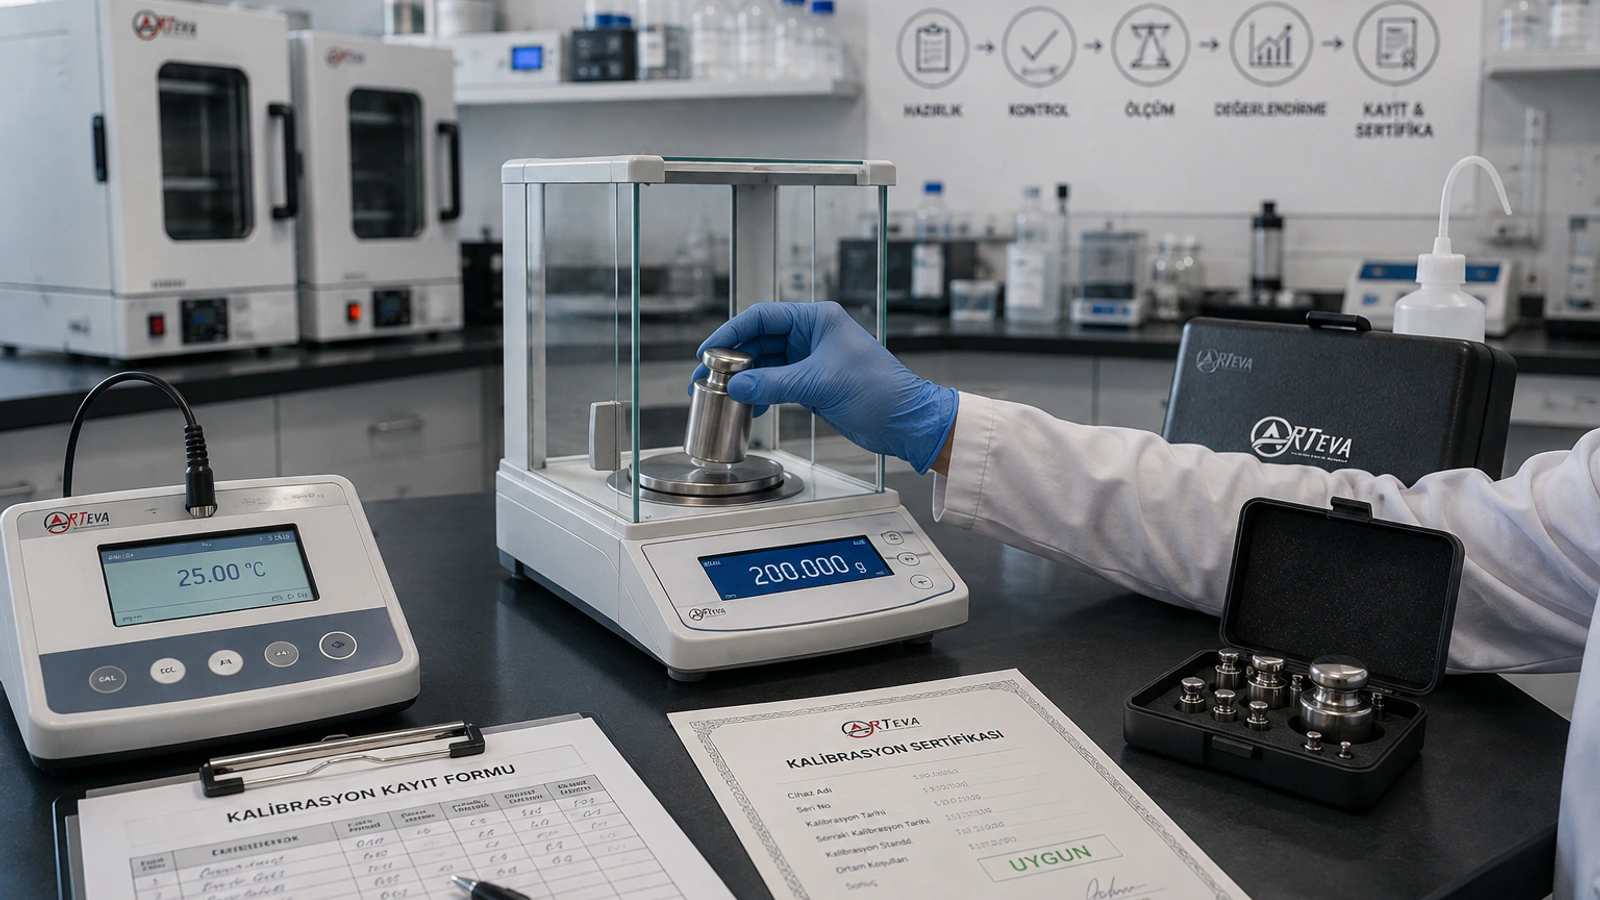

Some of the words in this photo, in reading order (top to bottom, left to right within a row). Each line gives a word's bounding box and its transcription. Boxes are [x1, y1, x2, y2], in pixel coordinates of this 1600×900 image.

[1008, 103, 1069, 118] KONTROL
[1125, 100, 1175, 119] ÖLÇÜM
[1214, 100, 1328, 118] DEĞERLENDİRME
[1363, 102, 1408, 118] KAYIT
[1413, 103, 1424, 117] &
[1355, 121, 1434, 139] SERTİFİKA
[177, 563, 240, 588] 25.00
[245, 561, 267, 579] °C
[749, 555, 849, 586] 200.000
[854, 561, 867, 574] g
[786, 743, 908, 770] KALİBRASYON
[910, 729, 1005, 752] SERTİFİKASI
[226, 788, 377, 824] KALİBRASYON
[381, 777, 439, 796] KAYIT
[445, 763, 517, 786] FORMU
[787, 790, 815, 800] Cihaz
[816, 787, 833, 796] Adı
[796, 806, 816, 814] Seri
[805, 814, 860, 829] Kalibrasyon
[860, 808, 887, 819] Tarihi
[851, 822, 905, 837] Kalibrasyon
[904, 817, 931, 828] Tarihi
[825, 844, 879, 858] Kalibrasyon
[1009, 845, 1092, 872] UYGUN
[836, 864, 867, 875] Ortam
